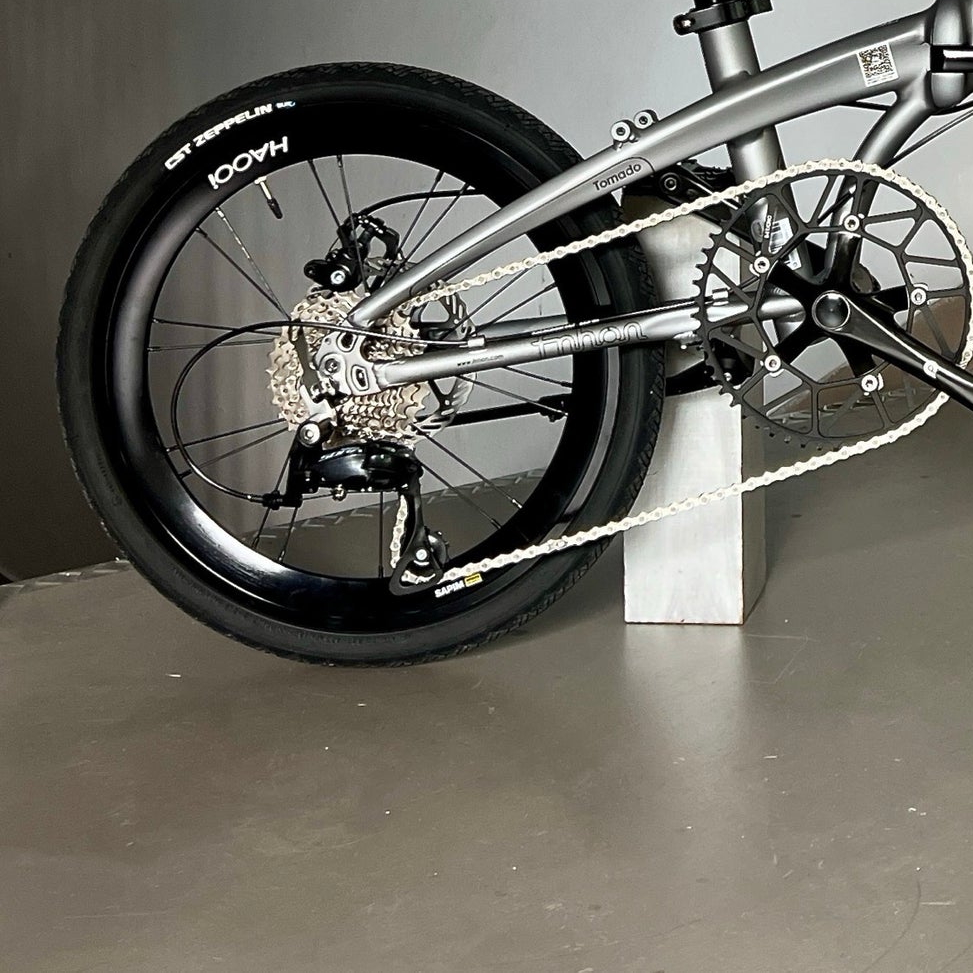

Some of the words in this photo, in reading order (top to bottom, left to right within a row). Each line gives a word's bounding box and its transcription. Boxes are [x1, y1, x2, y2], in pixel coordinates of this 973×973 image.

[164, 142, 192, 170] CST
[193, 103, 273, 147] ZEPPELIN
[434, 580, 465, 598] SAPIM
